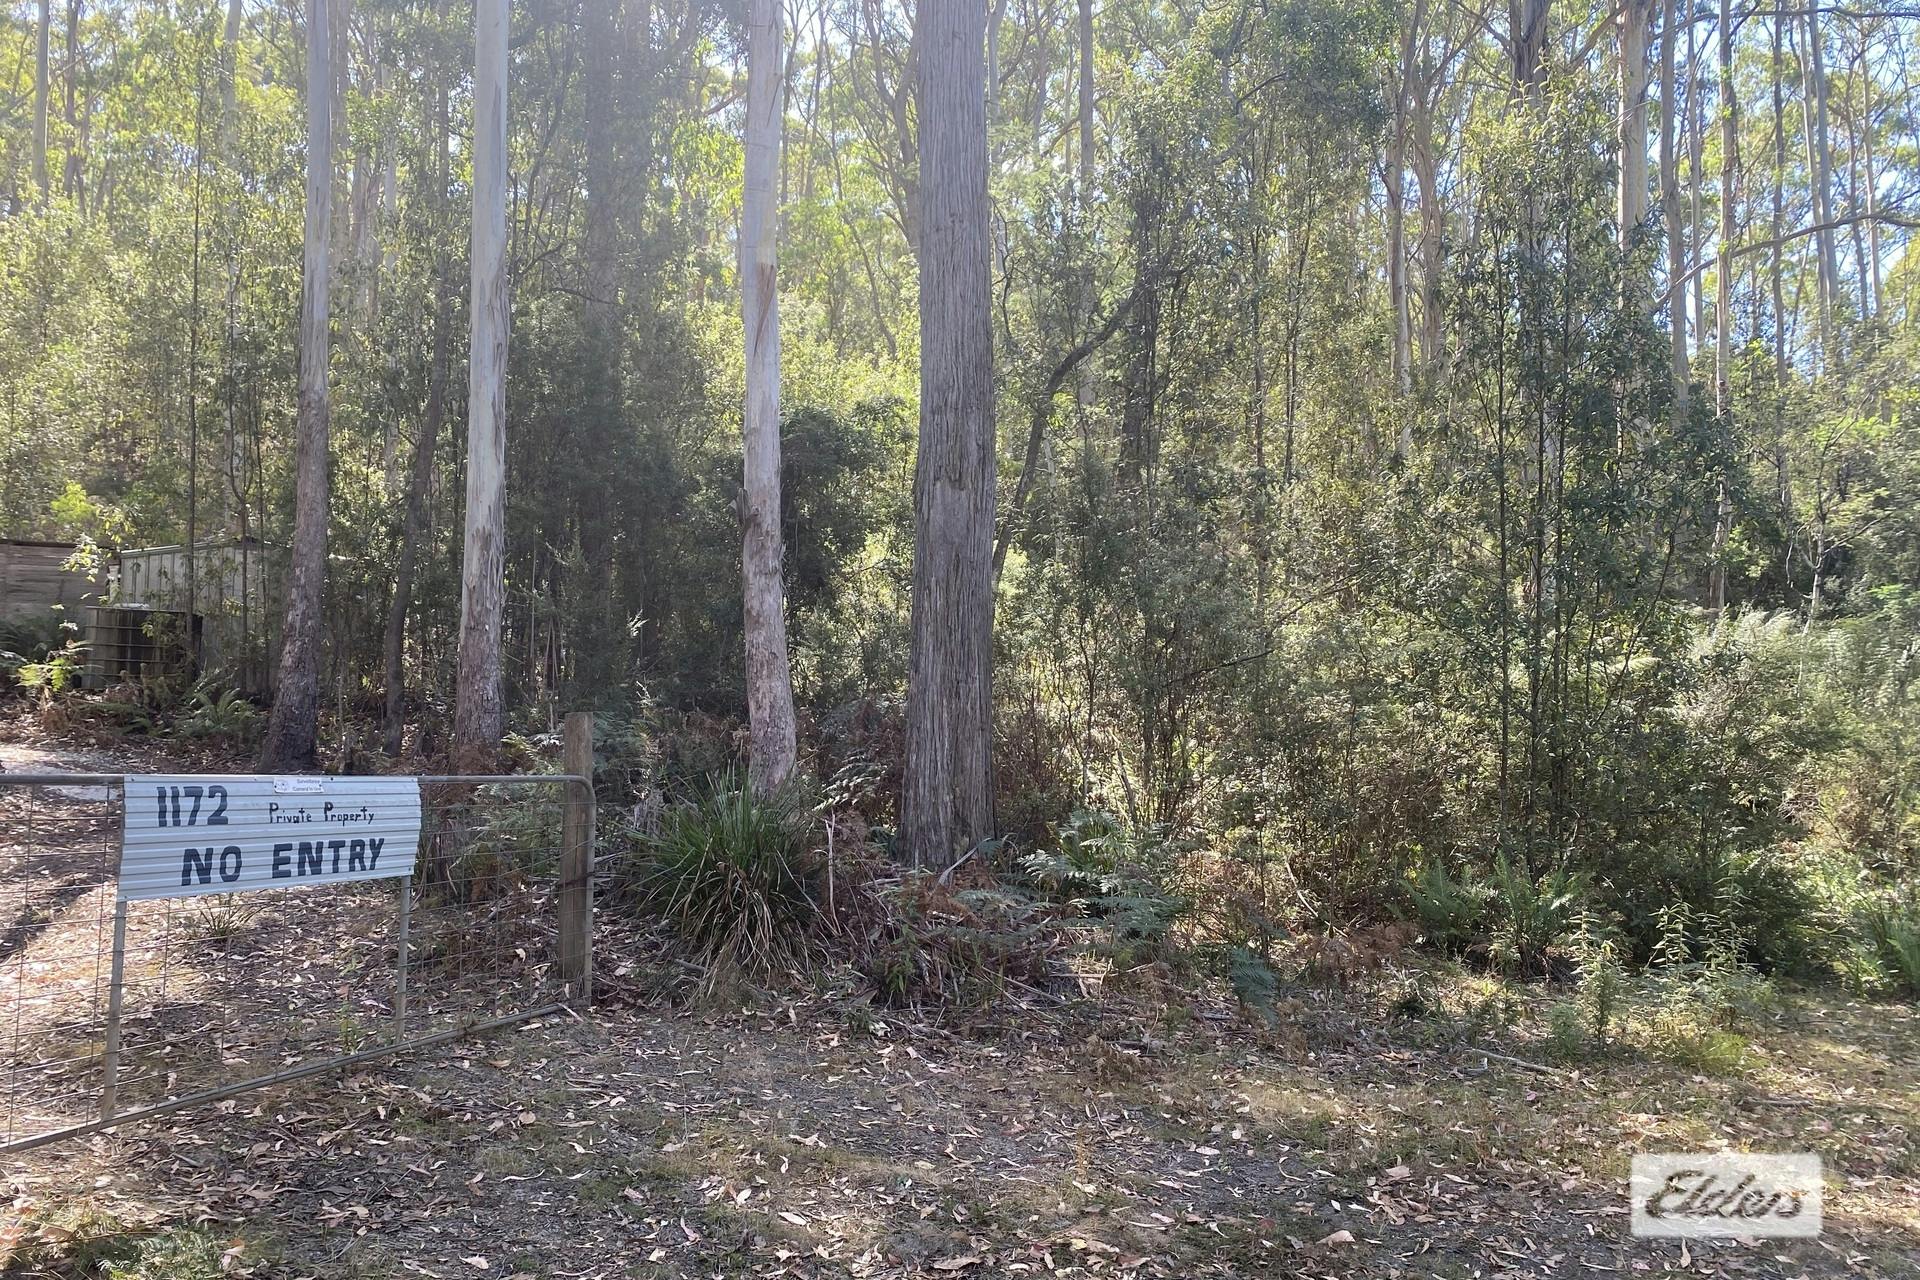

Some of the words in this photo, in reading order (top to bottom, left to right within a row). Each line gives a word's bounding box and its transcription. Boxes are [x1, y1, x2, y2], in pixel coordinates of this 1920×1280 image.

[157, 785, 229, 827] 1172
[269, 802, 312, 824] Private
[324, 801, 375, 826] Property
[181, 845, 242, 886] NO
[271, 838, 385, 879] ENTRY
